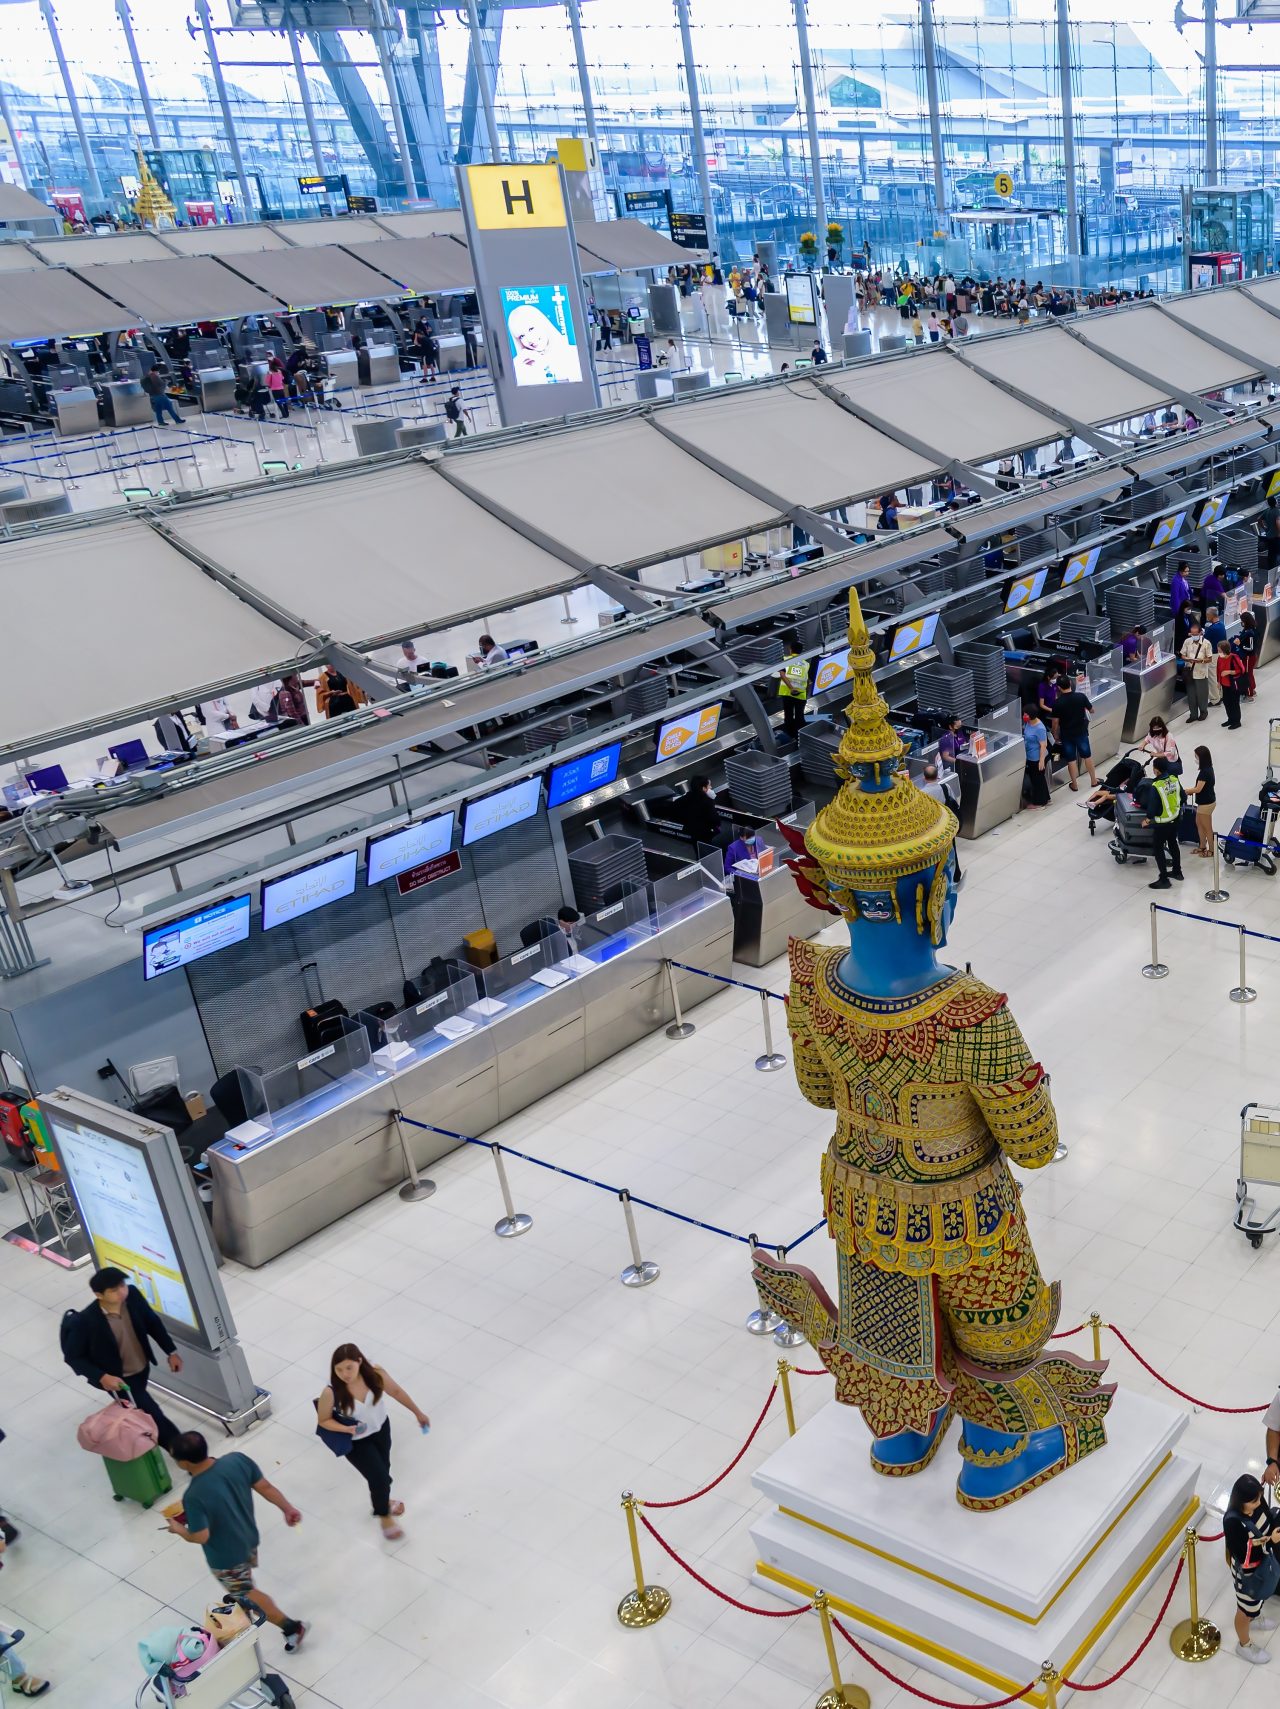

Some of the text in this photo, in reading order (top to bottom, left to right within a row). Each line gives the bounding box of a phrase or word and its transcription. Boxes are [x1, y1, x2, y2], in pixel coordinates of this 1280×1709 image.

[590, 142, 595, 167] J
[502, 180, 534, 214] H
[1000, 178, 1007, 194] 5
[474, 801, 529, 831] ETIHAD
[380, 839, 442, 870] ETIHAD
[417, 876, 427, 884] NOT
[428, 866, 451, 879] OBSTRUCT
[276, 880, 345, 914] ETIHAD
